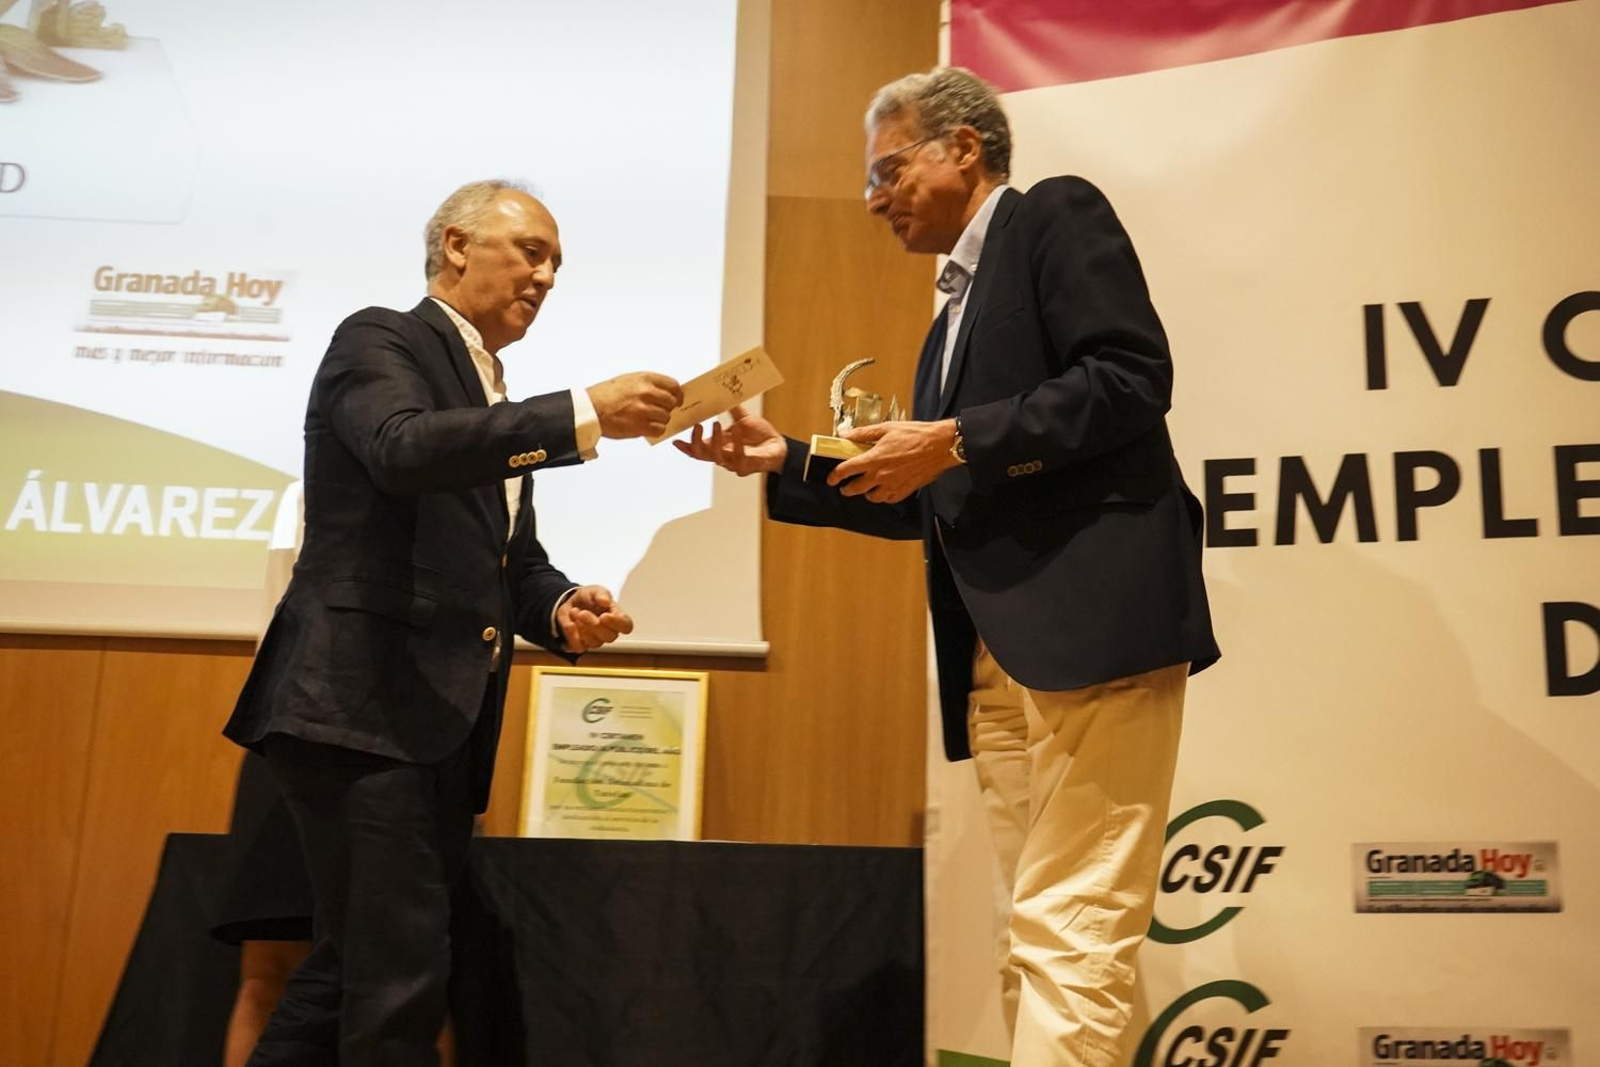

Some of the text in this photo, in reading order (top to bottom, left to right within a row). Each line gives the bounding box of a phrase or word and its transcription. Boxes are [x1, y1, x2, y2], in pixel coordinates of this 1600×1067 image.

[93, 265, 284, 306] Granada Hoy
[1362, 297, 1492, 391] IV
[5, 469, 274, 541] ÁLVAREZ
[1203, 443, 1600, 549] EMPLE
[1160, 844, 1286, 894] CSIF
[1366, 848, 1476, 874] Granada
[1480, 848, 1533, 878] Hoy
[1163, 1025, 1292, 1067] CSIF
[1373, 1034, 1486, 1060] Granada
[1490, 1034, 1547, 1065] Hoy
